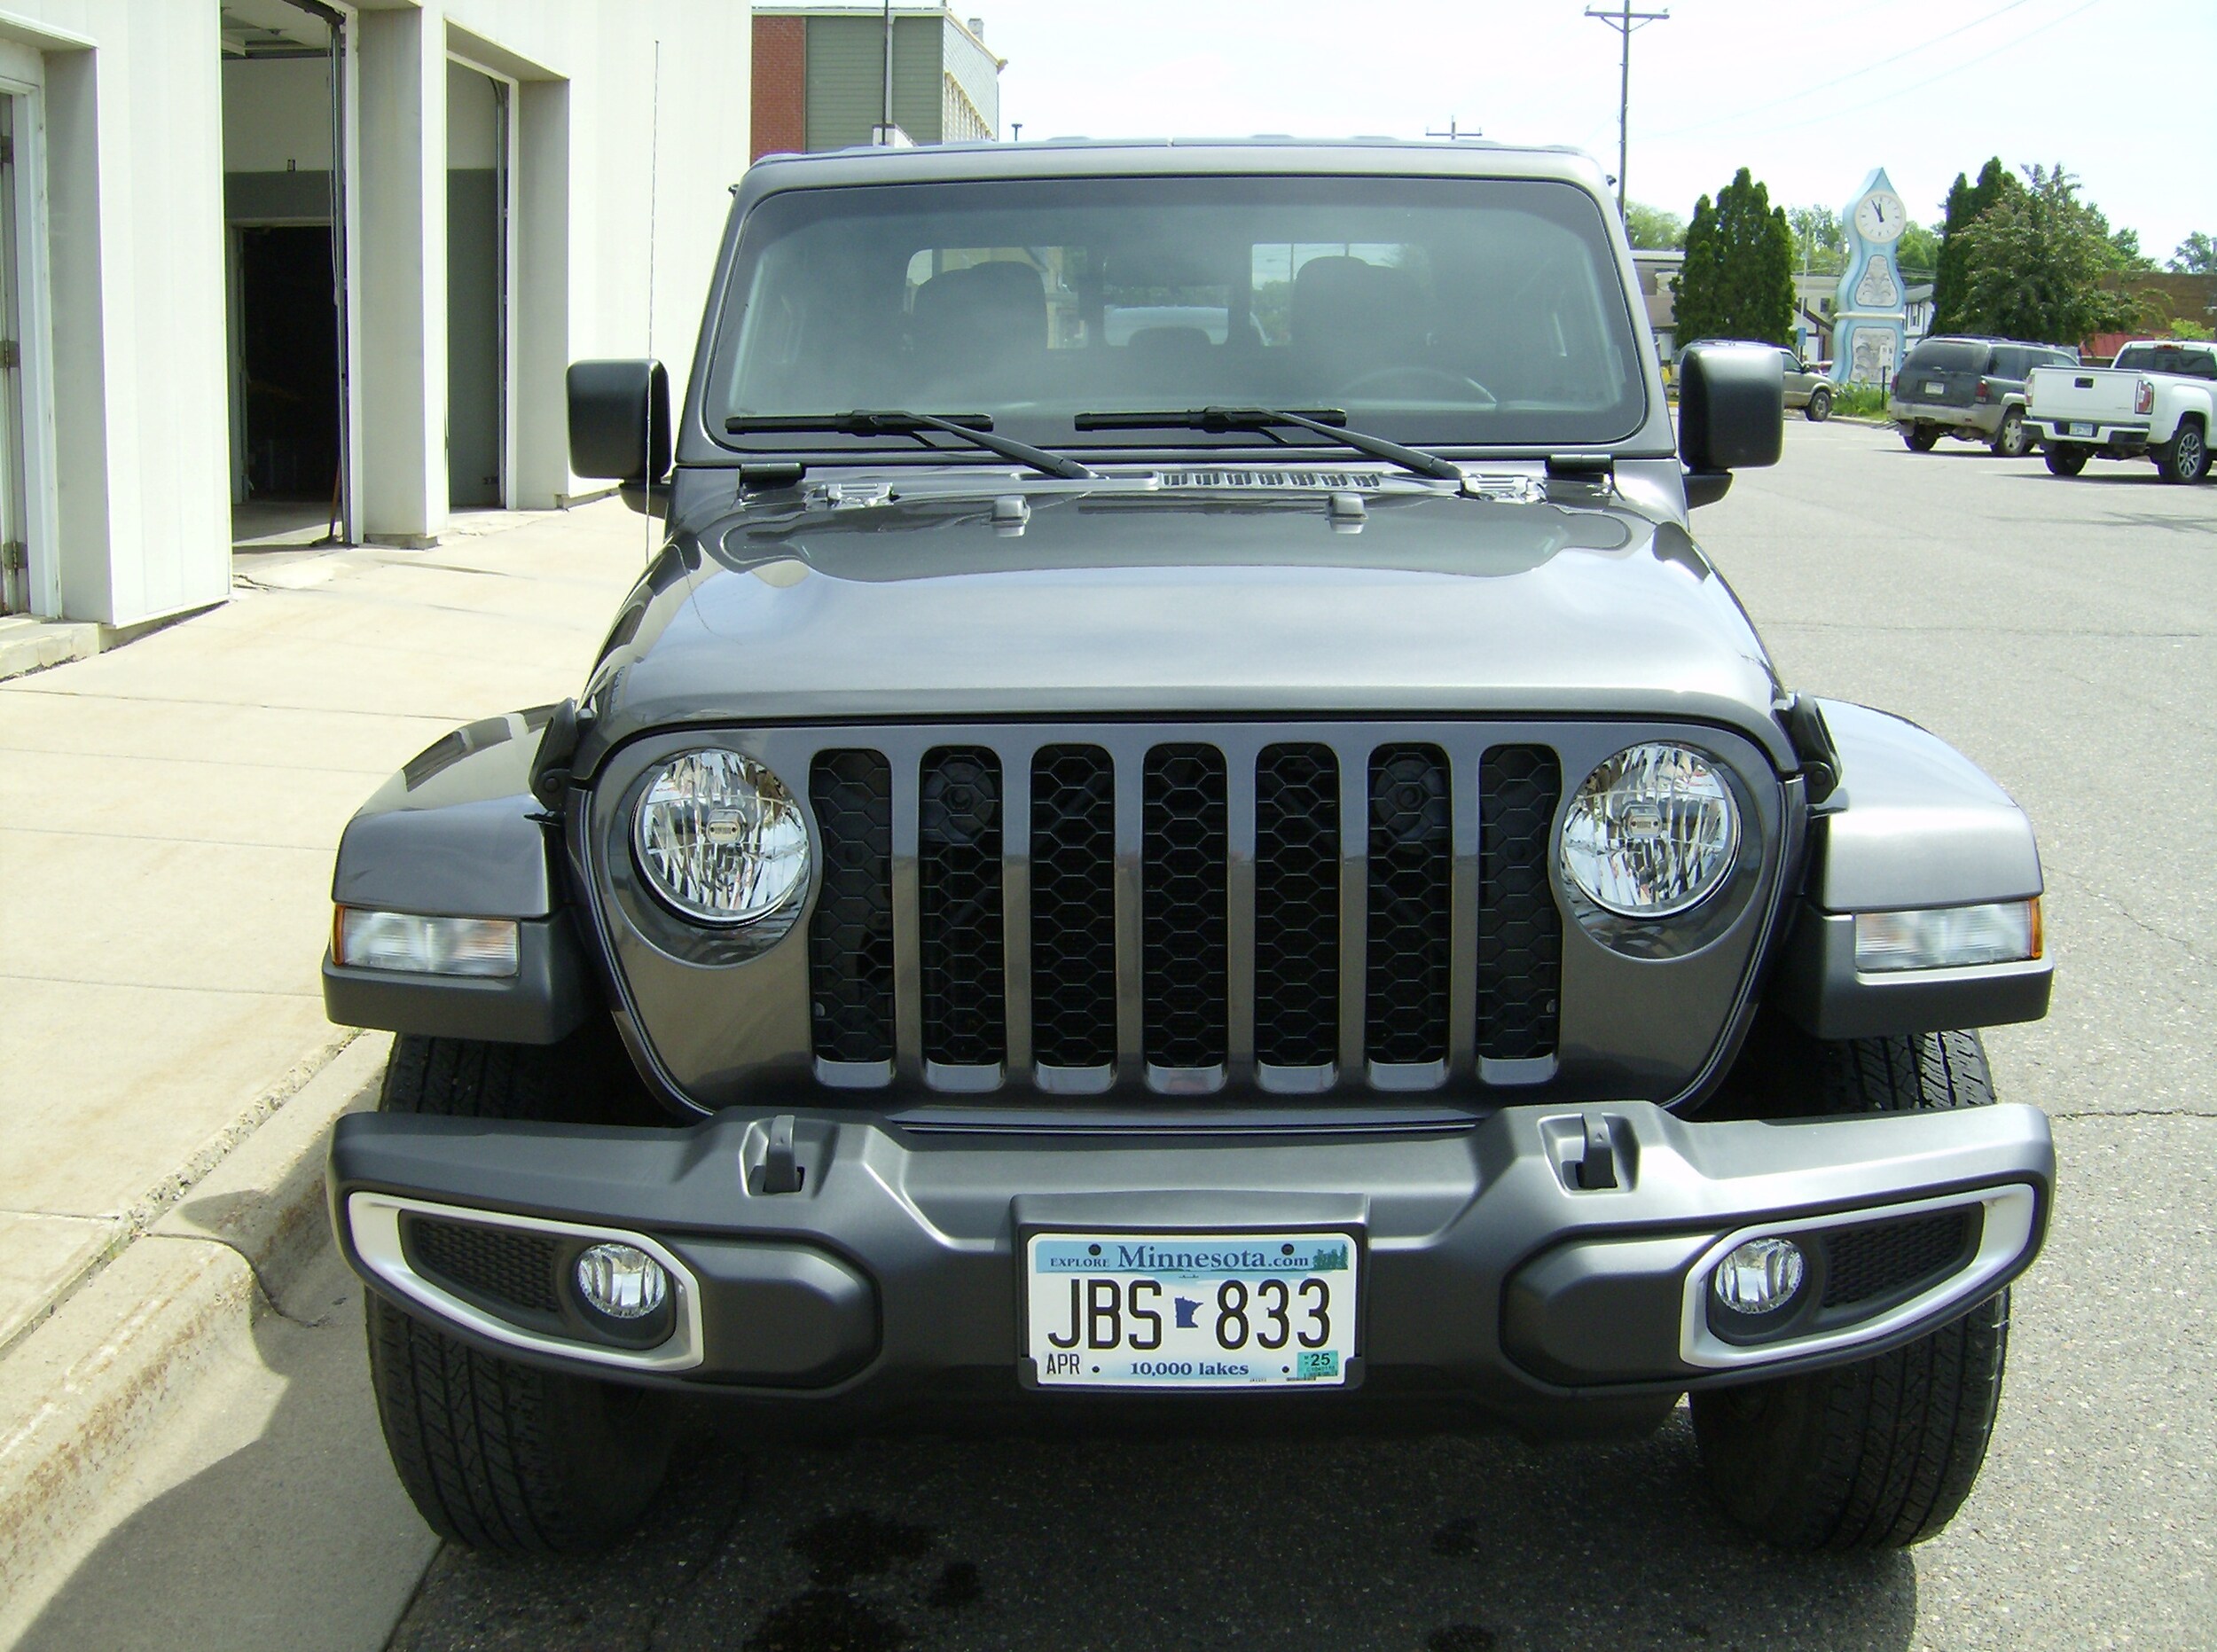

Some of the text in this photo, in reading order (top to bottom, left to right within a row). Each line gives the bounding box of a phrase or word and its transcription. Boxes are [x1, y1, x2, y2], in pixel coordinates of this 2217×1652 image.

[1050, 1257, 1109, 1267] EXPLORE
[1047, 1279, 1331, 1350] JBS 833
[1046, 1353, 1080, 1375] APR
[1311, 1353, 1331, 1366] 25
[1131, 1361, 1250, 1376] 10,000 lakes
